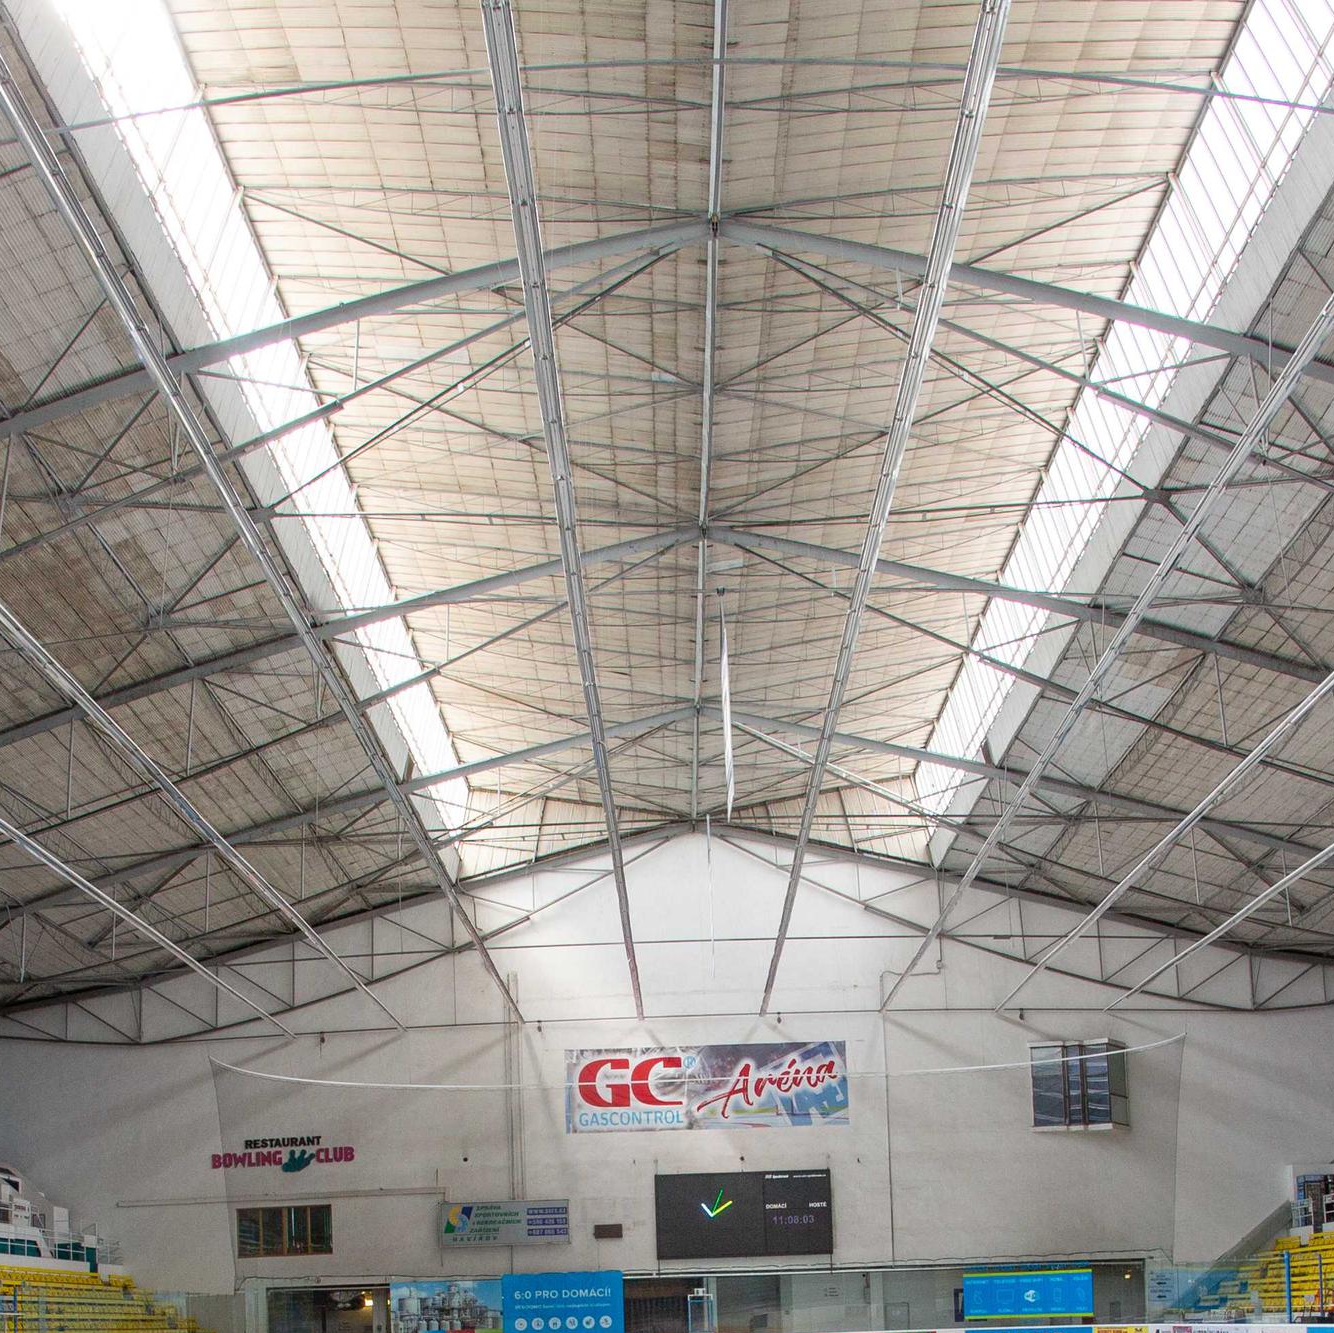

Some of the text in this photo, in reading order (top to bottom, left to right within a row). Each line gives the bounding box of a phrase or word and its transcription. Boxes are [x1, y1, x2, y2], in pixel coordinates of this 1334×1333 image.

[579, 1056, 683, 1108] GC
[697, 1059, 839, 1119] Aréna
[579, 1110, 684, 1127] GASCONTROL
[244, 1136, 322, 1149] RESTAURANT
[211, 1146, 355, 1169] BOWLING CLUB
[765, 1202, 787, 1210] DOMÁCÍ
[514, 1286, 611, 1300] 6:0 PRO DOMÁCÍ!
